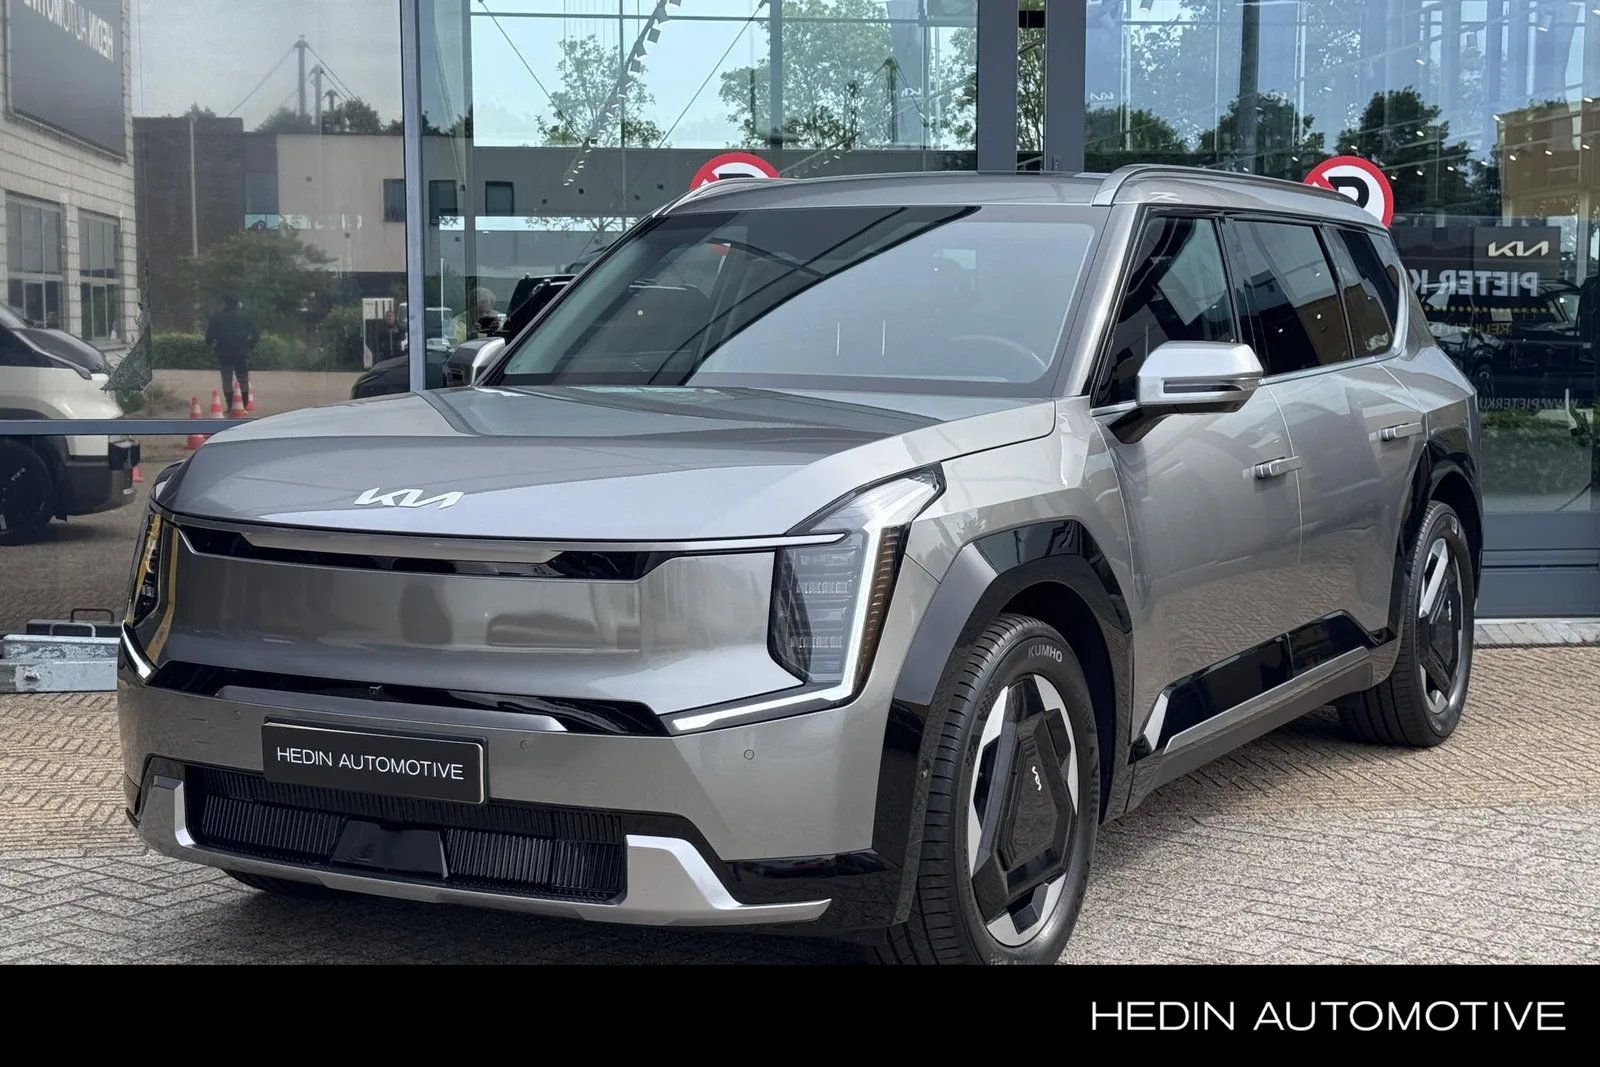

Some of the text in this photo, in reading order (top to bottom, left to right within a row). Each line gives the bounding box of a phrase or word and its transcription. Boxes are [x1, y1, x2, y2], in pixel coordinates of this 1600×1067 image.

[1488, 240, 1549, 257] KIA
[354, 487, 465, 510] KIA
[1028, 644, 1063, 663] KUMHO
[276, 746, 464, 780] HEDIN AUTOMOTIVE
